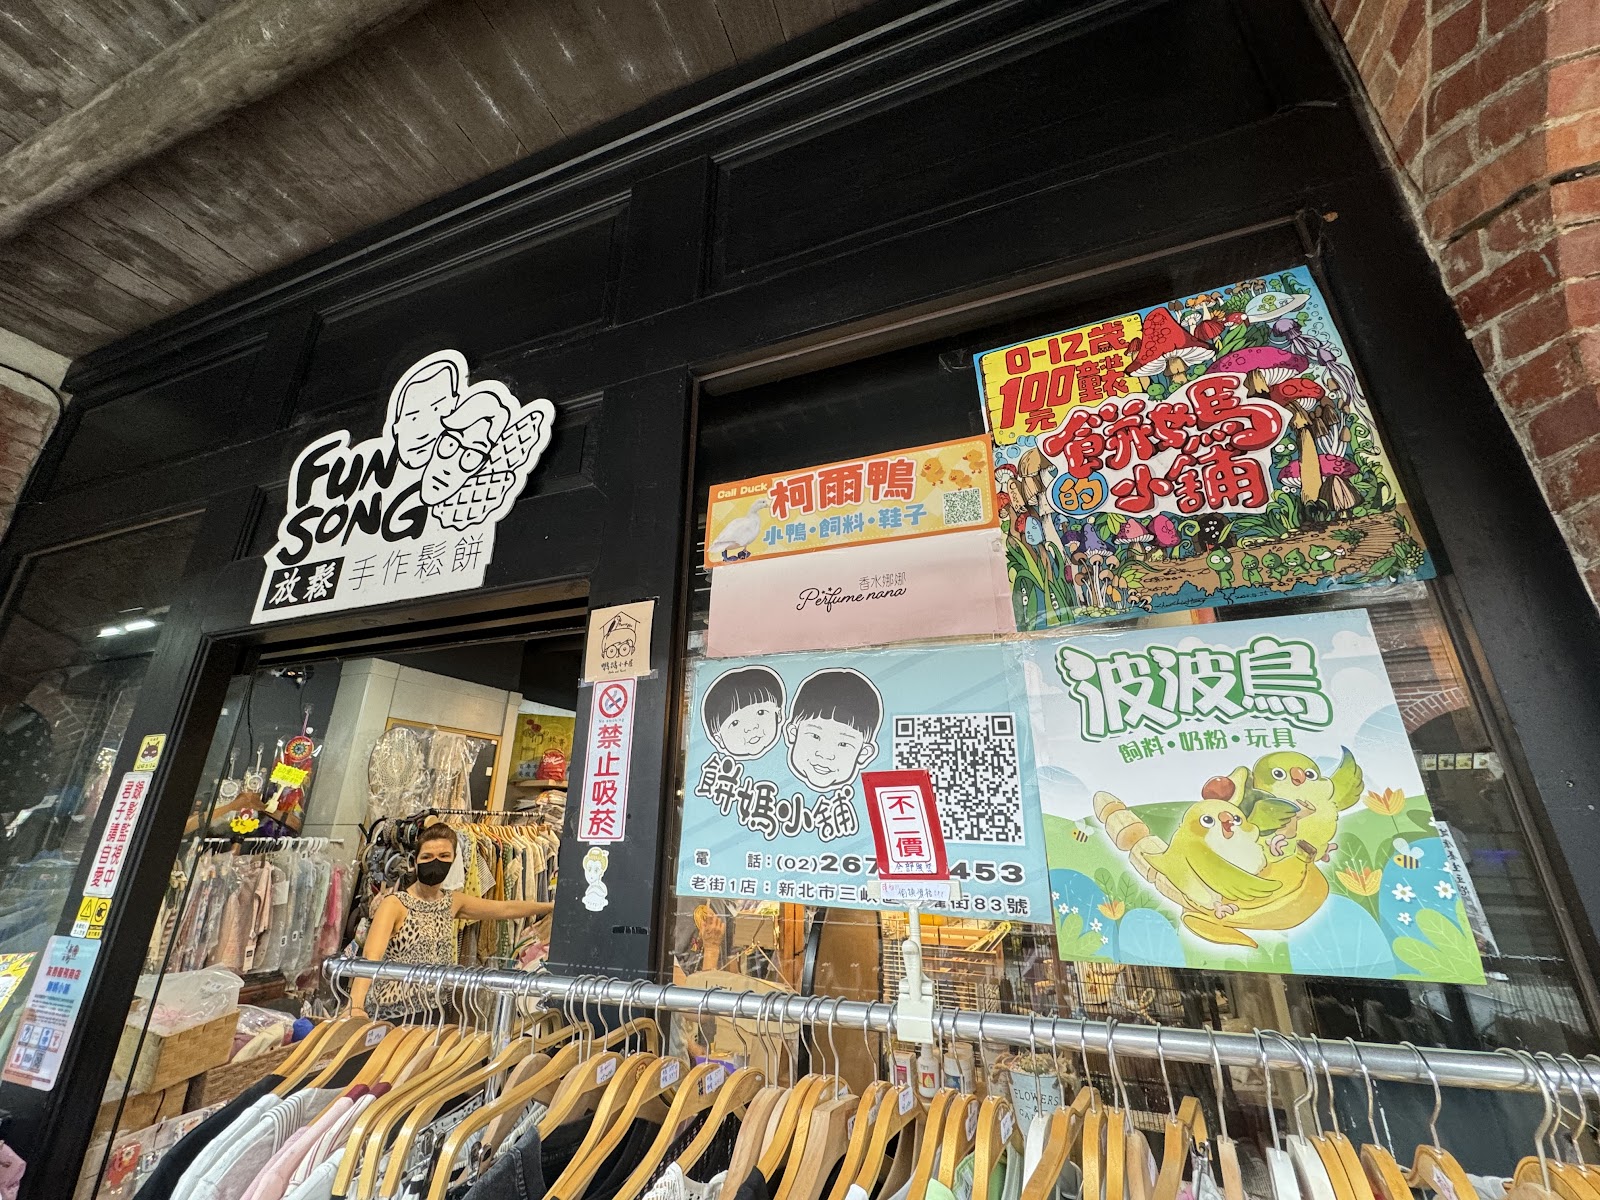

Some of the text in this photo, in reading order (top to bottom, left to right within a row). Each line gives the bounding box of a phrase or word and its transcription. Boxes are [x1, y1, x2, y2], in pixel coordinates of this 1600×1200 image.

[1005, 321, 1130, 375] 0-12歲
[296, 439, 400, 509] FUN
[717, 482, 768, 499] Call Duck
[770, 458, 914, 519] 柯爾鴨
[276, 480, 428, 566] SONG
[348, 532, 484, 591] 手作鬆餅
[859, 571, 907, 591] 香水娜娜
[796, 586, 907, 613] Perfume nana
[1057, 637, 1333, 741] 波波鳥
[587, 723, 623, 837] 禁止吸菸
[90, 780, 135, 888] 君子請自愛
[887, 795, 925, 858] 不二價
[1013, 1088, 1059, 1106] FLOWERS
